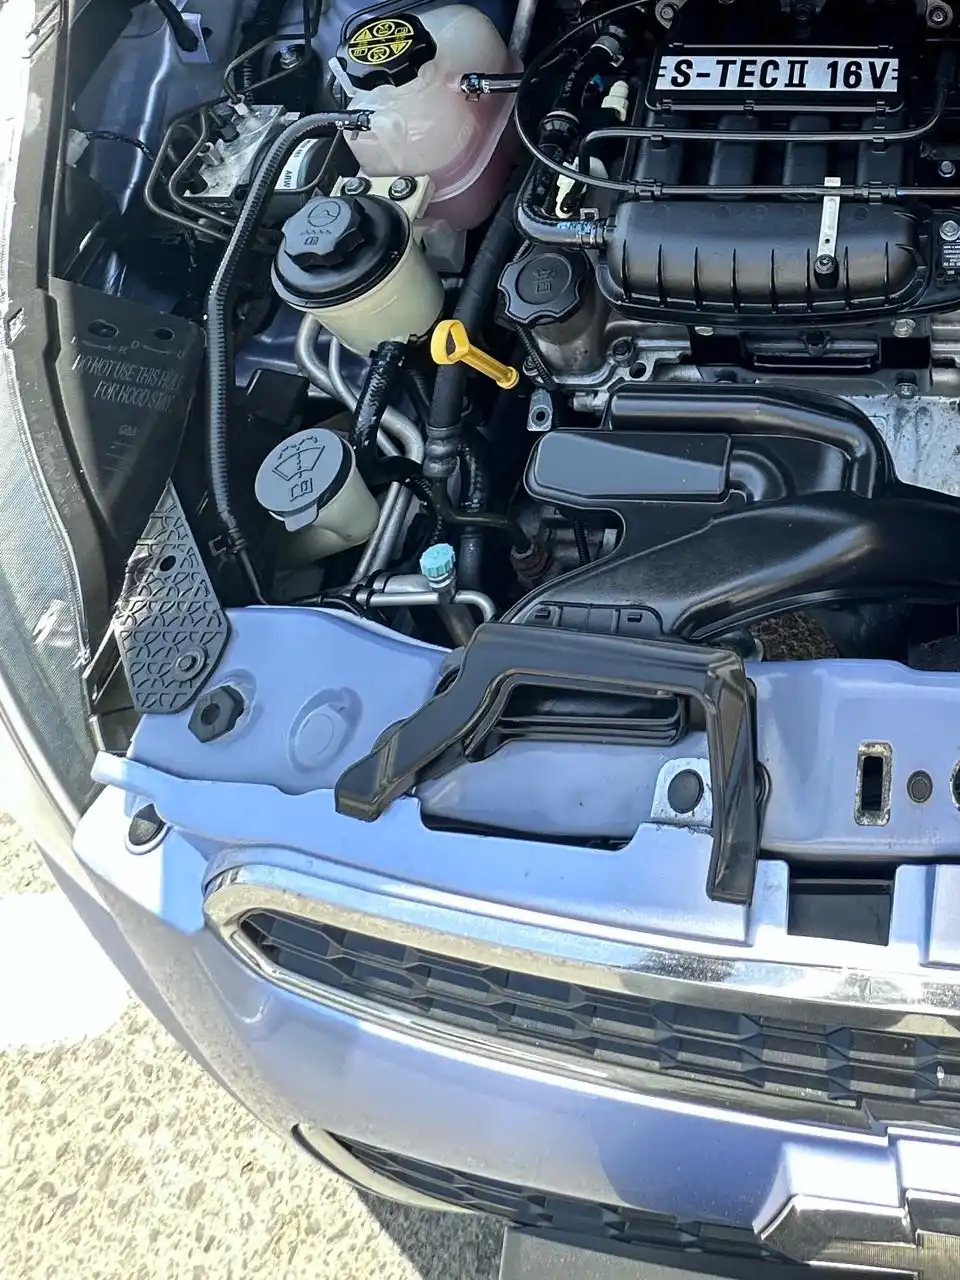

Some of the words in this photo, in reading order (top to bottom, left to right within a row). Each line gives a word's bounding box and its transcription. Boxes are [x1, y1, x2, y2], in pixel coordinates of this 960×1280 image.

[827, 60, 890, 89] 16V
[284, 170, 292, 188] ARW
[90, 357, 113, 377] NOT
[114, 361, 136, 382] USE
[136, 365, 159, 387] THIS
[93, 380, 118, 402] FOR
[118, 384, 150, 407] HOOD
